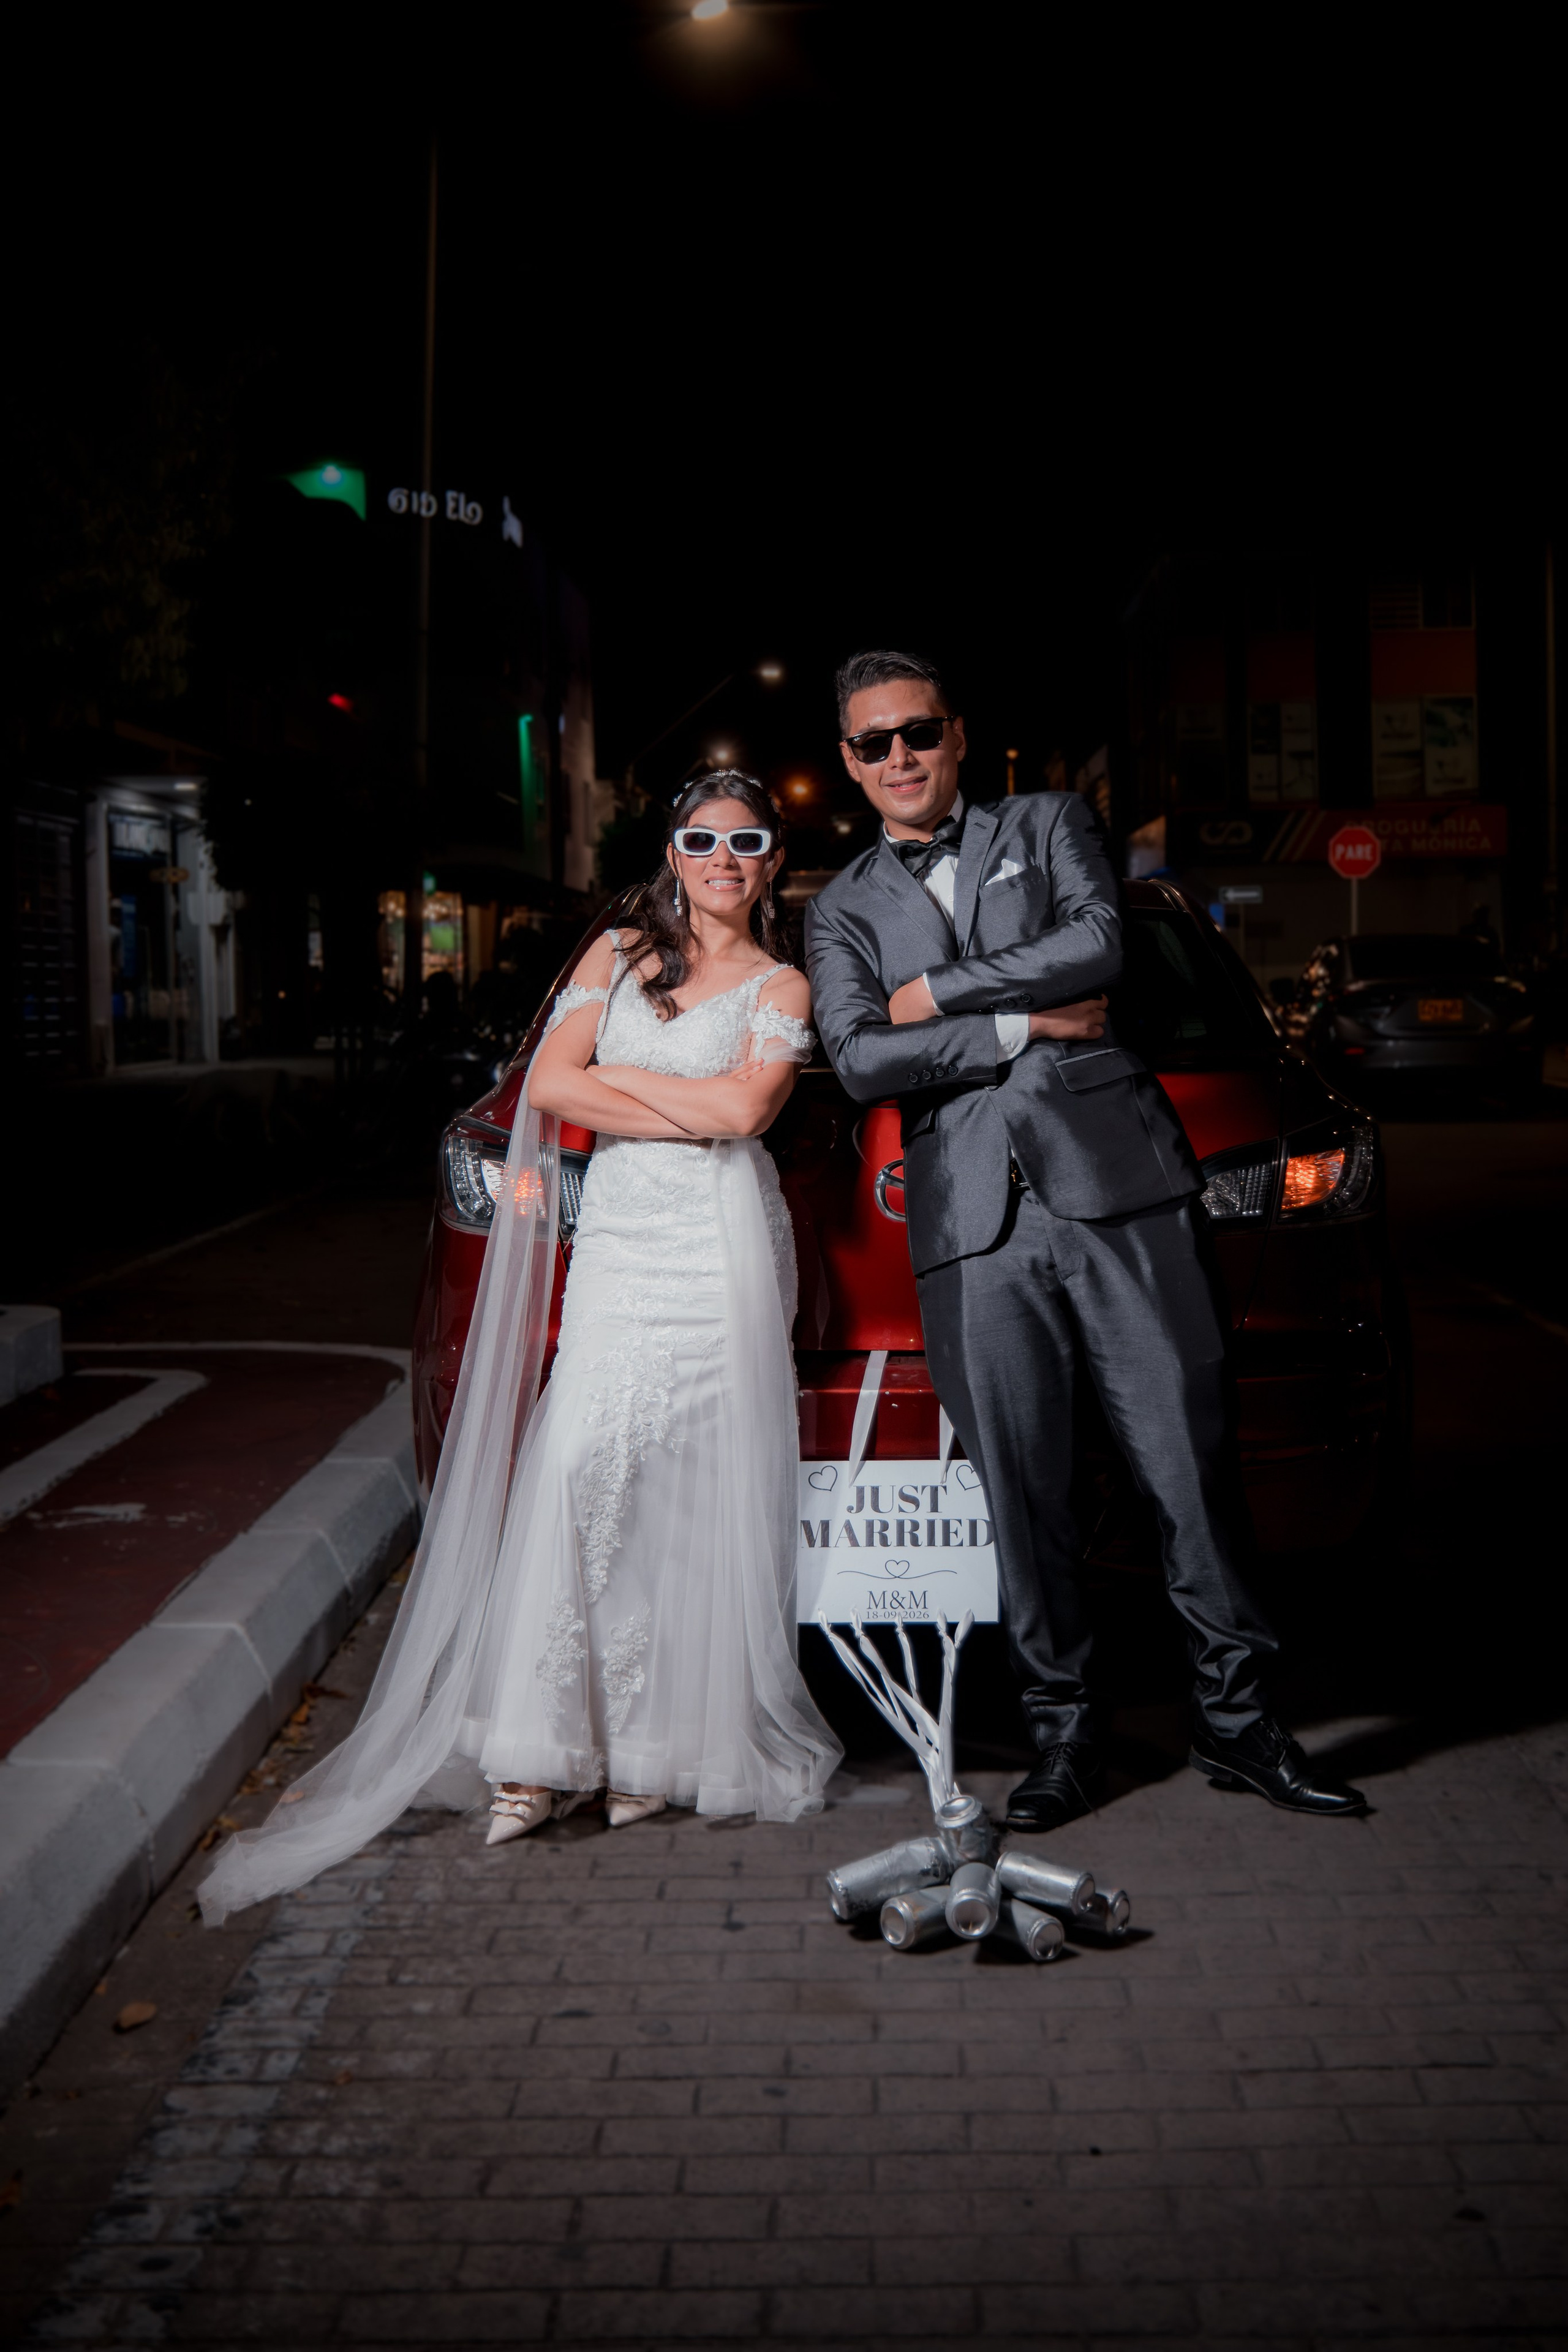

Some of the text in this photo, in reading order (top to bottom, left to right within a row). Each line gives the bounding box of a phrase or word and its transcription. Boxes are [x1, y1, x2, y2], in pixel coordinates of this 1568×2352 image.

[1335, 843, 1374, 861] PARE
[846, 1485, 948, 1514] JUST
[800, 1518, 995, 1548] MARRIED
[867, 1590, 929, 1610] M&M
[866, 1610, 930, 1619] 18-092026
